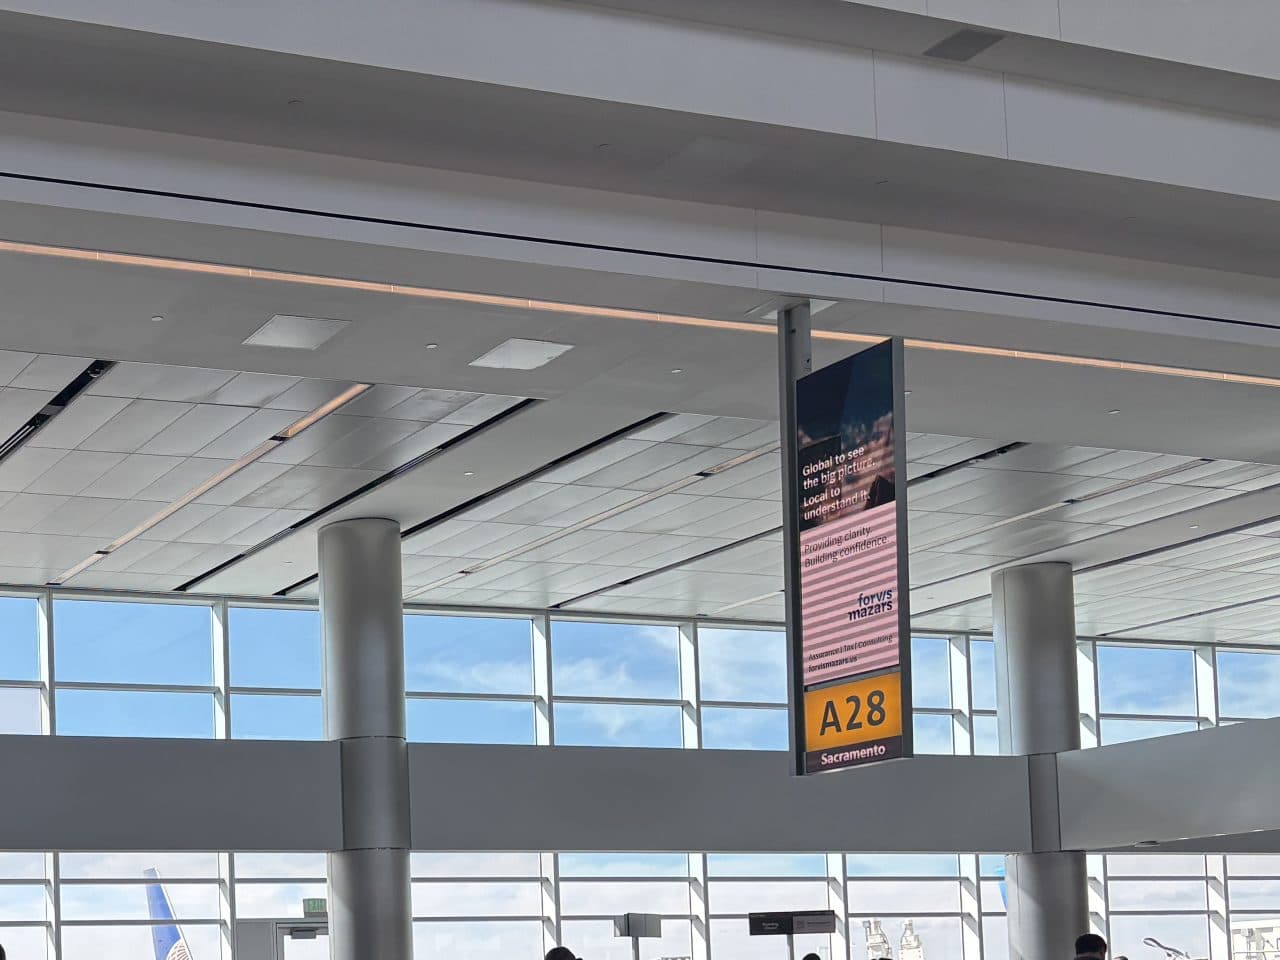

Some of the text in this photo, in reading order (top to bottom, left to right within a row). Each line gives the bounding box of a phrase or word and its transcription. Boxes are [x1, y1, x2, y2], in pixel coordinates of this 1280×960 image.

[802, 446, 865, 476] Global to see
[803, 457, 876, 490] the big picture.
[803, 487, 841, 507] Local to
[803, 493, 858, 520] understand
[804, 526, 873, 554] Providing clarity.
[804, 536, 890, 568] Building confidence.
[847, 600, 893, 621] mazars
[819, 689, 886, 737] A28
[820, 744, 886, 766] Sacramento
